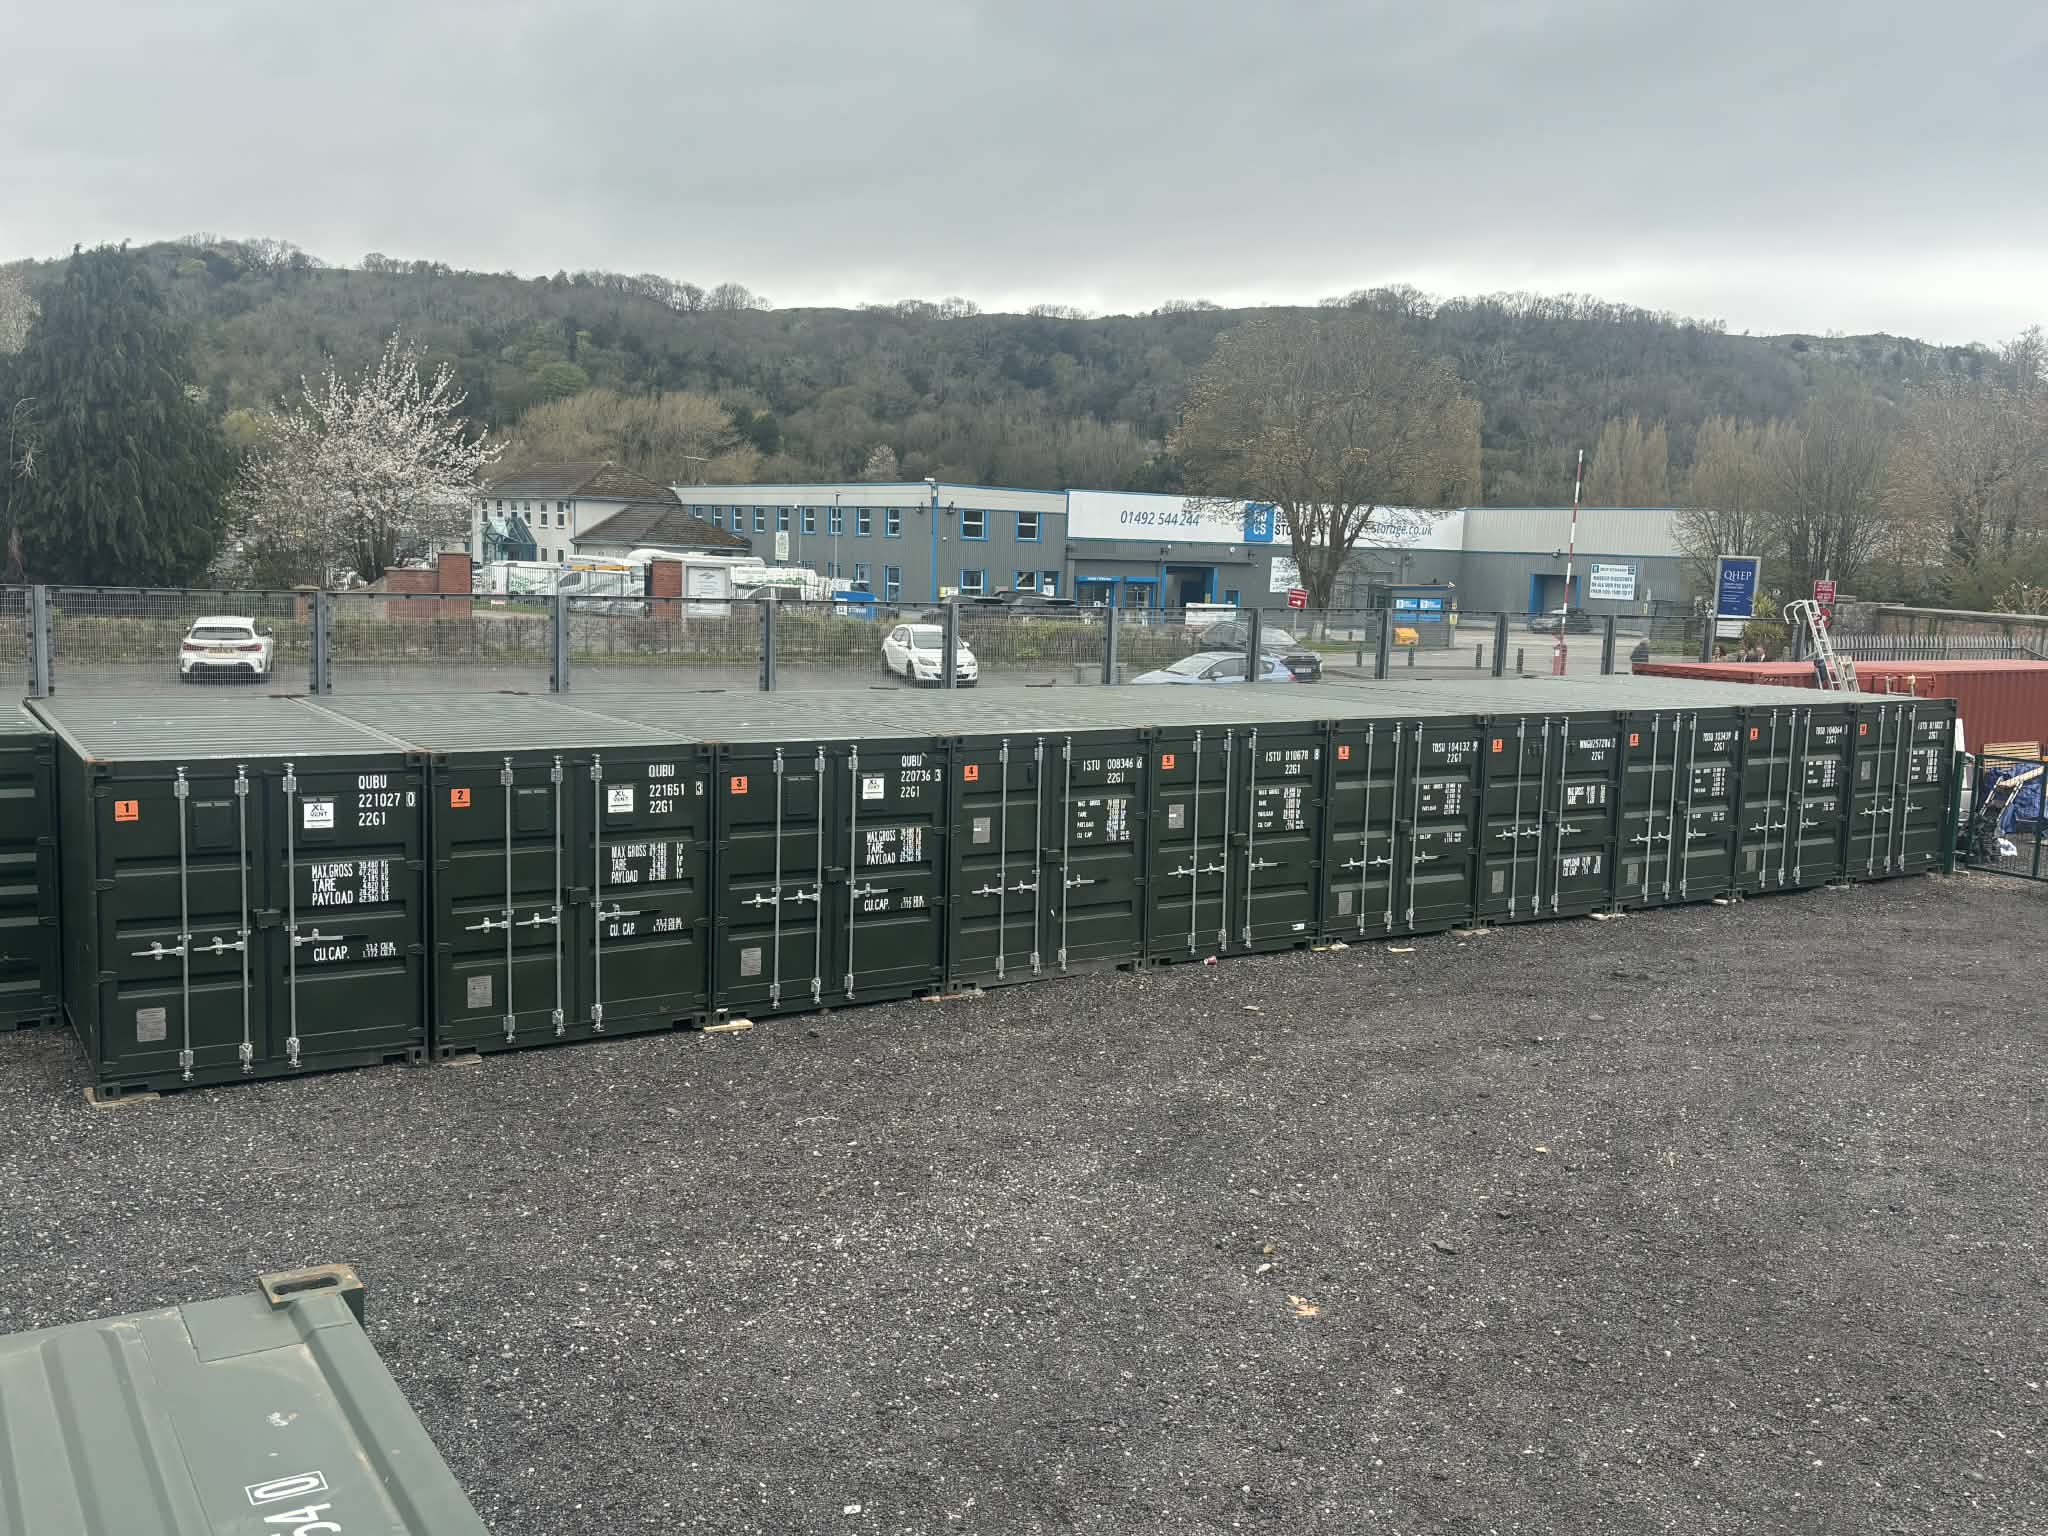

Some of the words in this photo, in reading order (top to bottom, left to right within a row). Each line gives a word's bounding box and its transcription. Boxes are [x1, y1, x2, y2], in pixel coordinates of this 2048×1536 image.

[1120, 510, 1155, 525] 01492
[1253, 523, 1266, 535] CS
[1724, 570, 1752, 582] QHEP
[1448, 741, 1470, 752] 104132
[1265, 751, 1281, 762] ISTU
[1446, 752, 1462, 763] 22G1
[1591, 751, 1604, 760] 22G1
[1083, 759, 1101, 772] ISTU
[1107, 757, 1134, 770] 008346
[1284, 764, 1301, 775] 22G1
[358, 774, 388, 790] QUBU
[900, 769, 931, 782] 220736
[934, 769, 942, 782] 3
[1107, 771, 1124, 784] 22G1
[649, 783, 685, 798] 221651
[695, 781, 703, 796] 3
[736, 778, 742, 788] 3
[457, 790, 464, 800] 2
[900, 786, 920, 798] 22G1
[358, 792, 401, 808] 221027
[406, 792, 416, 807] 0
[649, 799, 673, 814] 22G1
[124, 802, 130, 813] 1
[358, 811, 386, 827] 22G1
[627, 844, 647, 858] GROSS
[866, 842, 885, 855] TARE
[866, 852, 896, 865] PAYLOAD
[611, 869, 638, 884] PAYLOAD
[312, 877, 337, 892] TARE
[312, 890, 354, 906] PAYLOAD
[252, 1474, 322, 1501] 0
